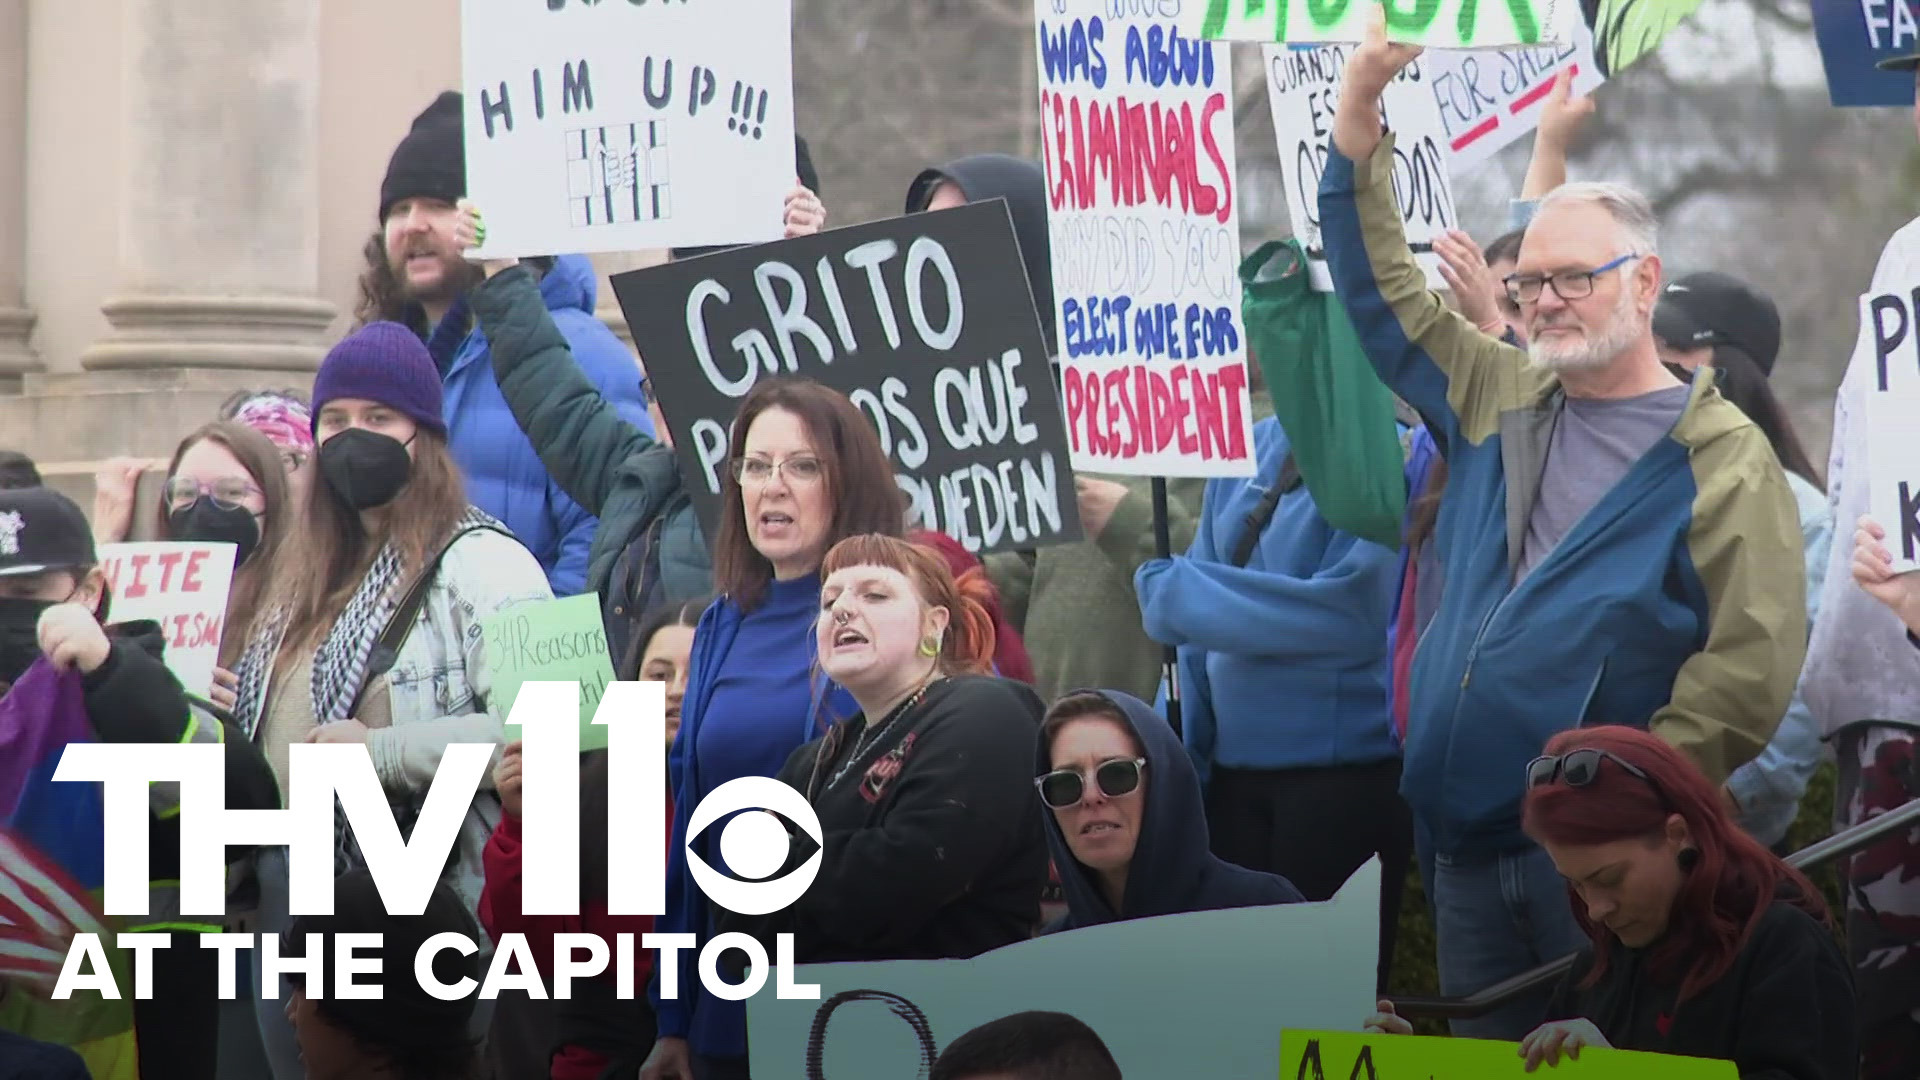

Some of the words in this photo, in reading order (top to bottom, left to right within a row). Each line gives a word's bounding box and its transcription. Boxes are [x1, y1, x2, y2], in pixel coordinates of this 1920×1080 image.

[1041, 16, 1107, 90] WAS
[481, 59, 594, 139] HIM
[1432, 56, 1496, 138] FOR
[1041, 89, 1231, 224] CRIMINALS
[1104, 215, 1156, 296] DID
[1161, 218, 1235, 300] YOU
[685, 235, 964, 398] GRITO
[1062, 294, 1132, 359] ELECT
[1134, 302, 1183, 361] ONE
[1185, 302, 1239, 360] FOR
[933, 348, 1039, 451] QUE
[1064, 363, 1248, 462] PRESIDENT
